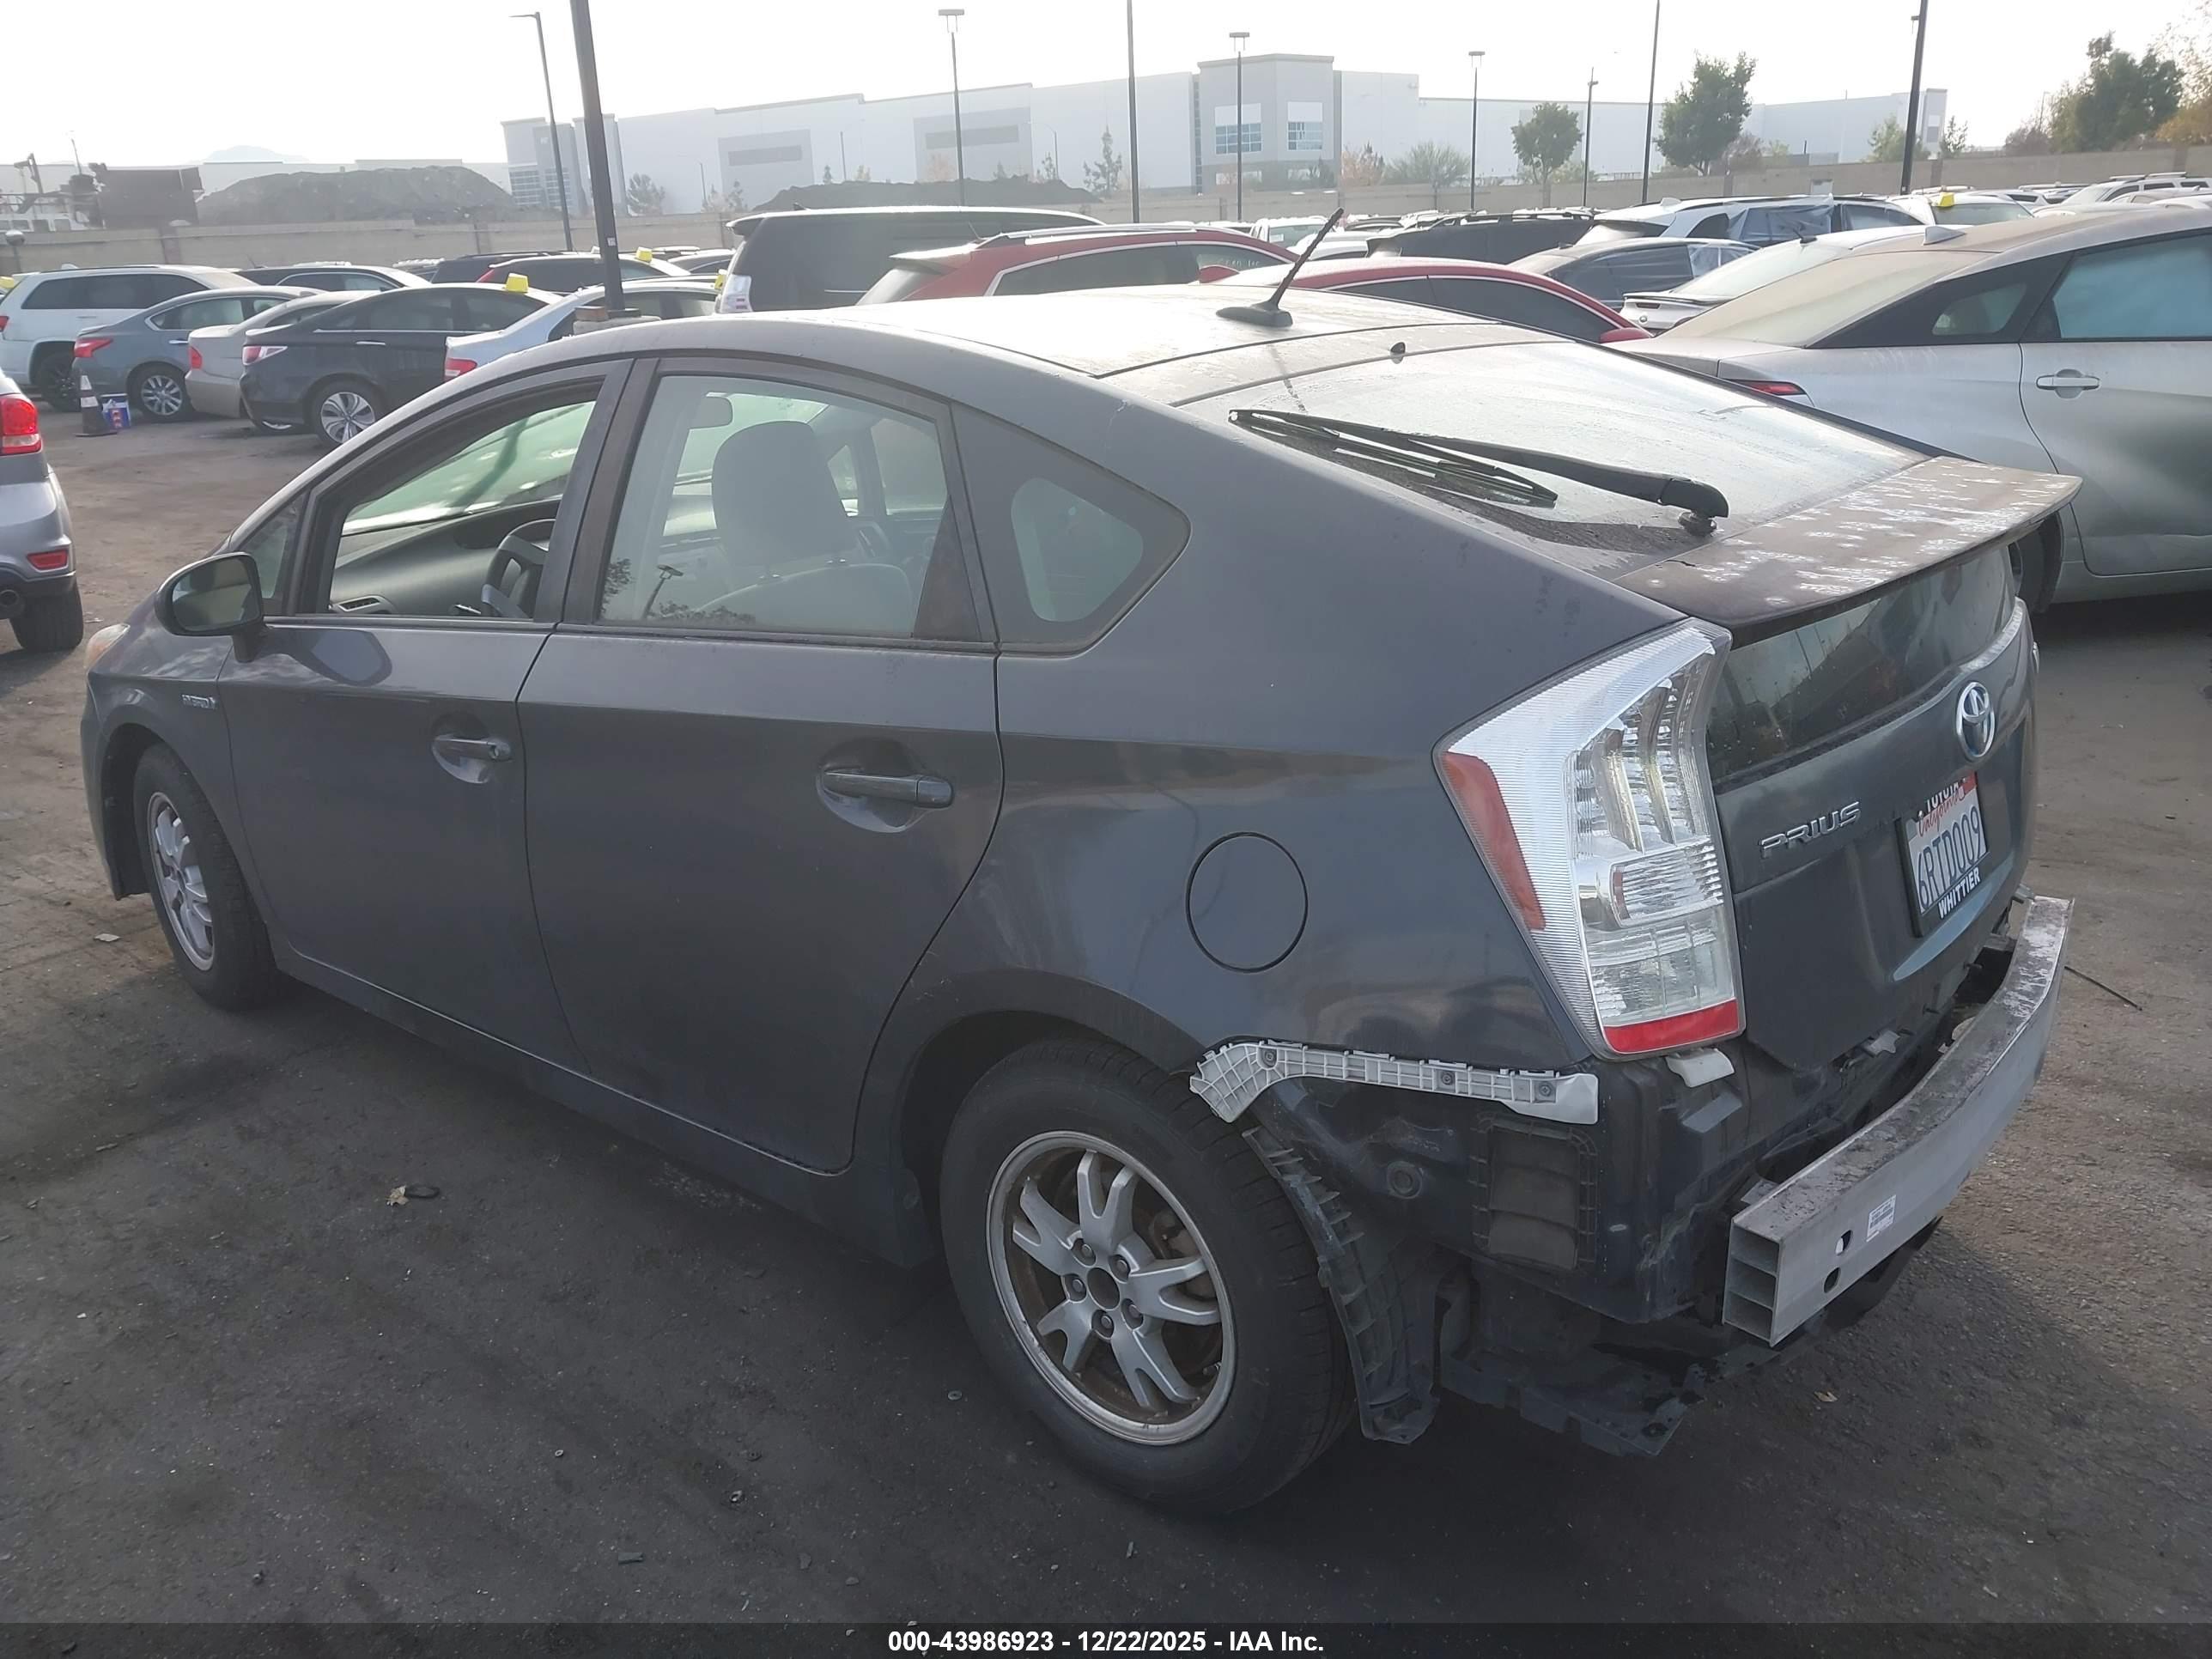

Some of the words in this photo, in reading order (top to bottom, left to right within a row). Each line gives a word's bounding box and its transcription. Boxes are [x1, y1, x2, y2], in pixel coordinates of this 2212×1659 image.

[1759, 800, 1861, 859] PRIUS
[1917, 805, 1982, 909] 6RTD009
[1937, 866, 1981, 920] WHITTIER
